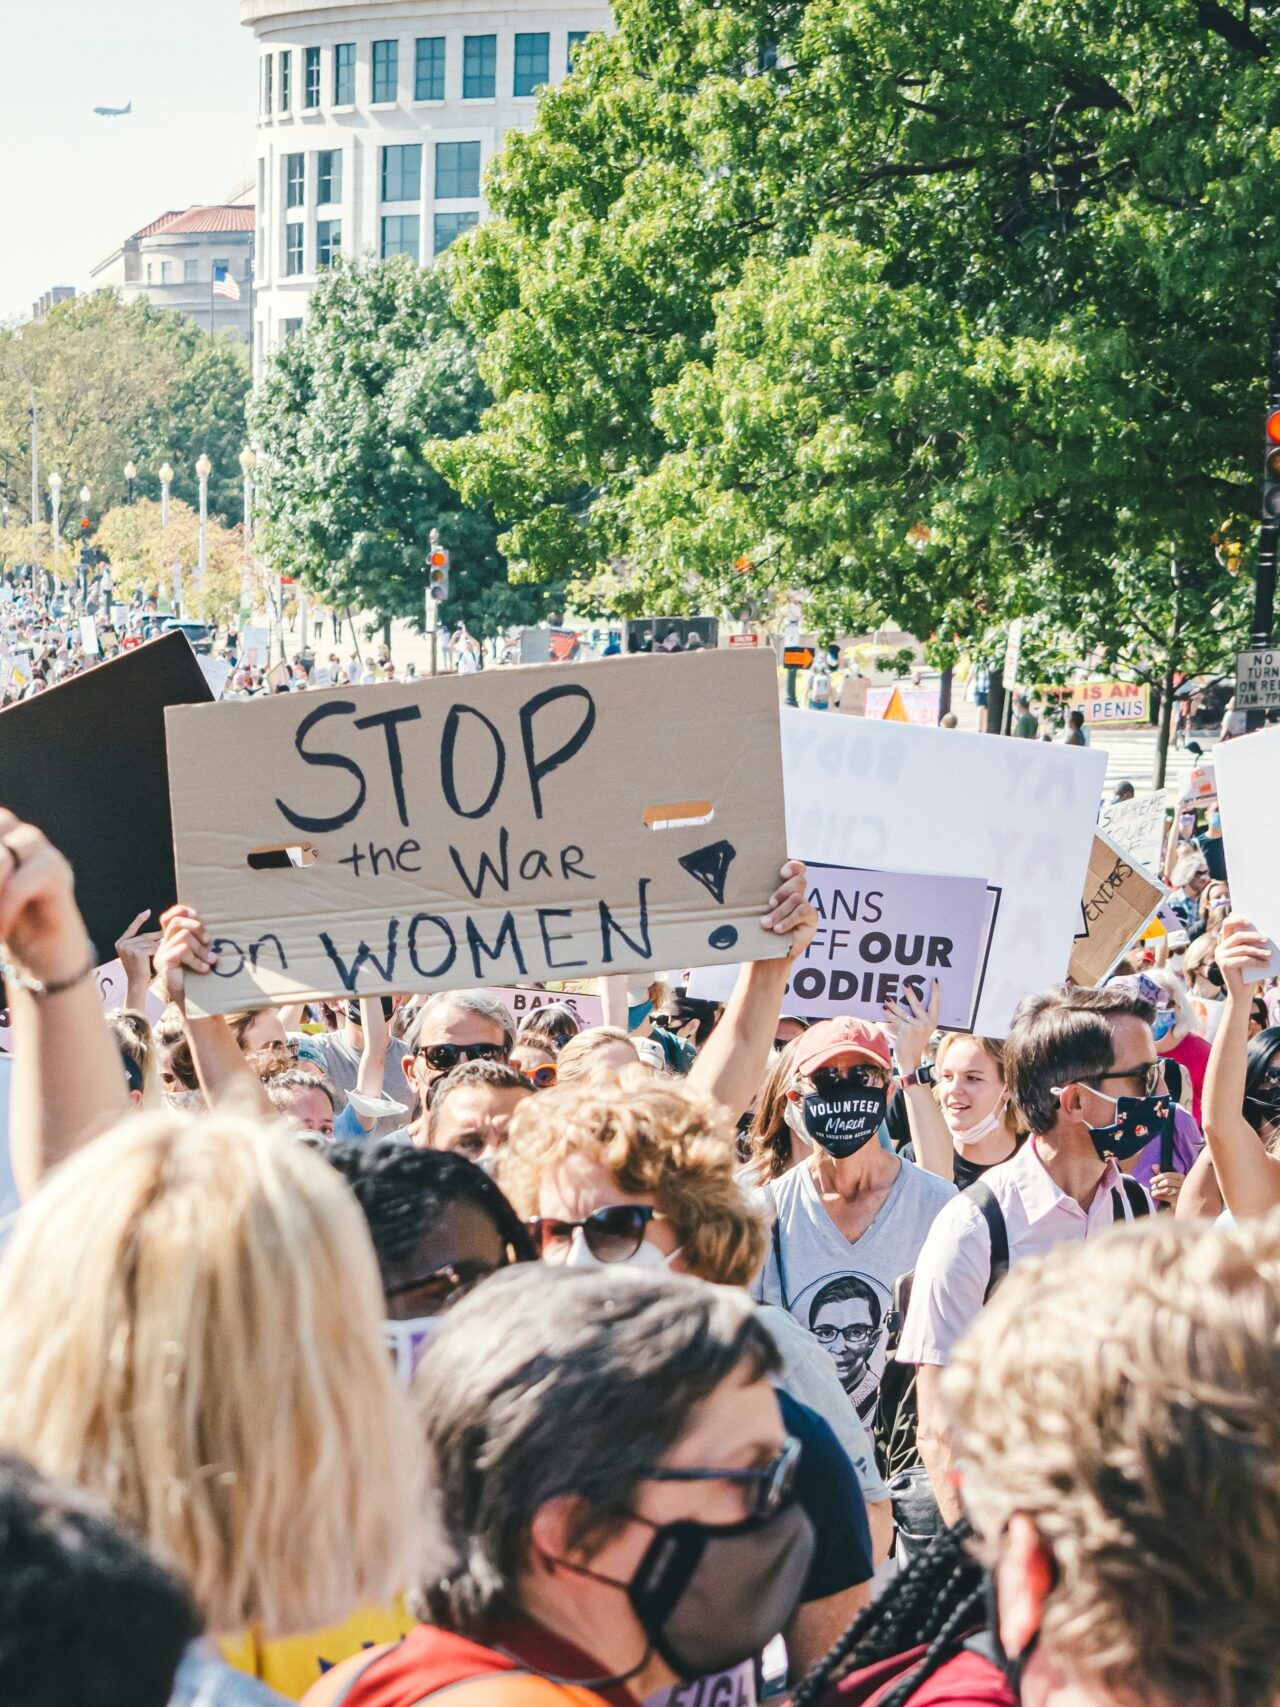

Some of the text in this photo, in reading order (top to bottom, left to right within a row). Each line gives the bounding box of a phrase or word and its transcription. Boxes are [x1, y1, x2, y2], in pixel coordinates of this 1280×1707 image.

[1253, 654, 1273, 666] NO
[1248, 667, 1279, 679] TURN
[1083, 685, 1139, 700] IS AN
[1239, 679, 1280, 692] ON RE
[1239, 693, 1280, 705] 7AM-7P
[1092, 700, 1144, 718] PENIS
[274, 683, 597, 833] STOP
[338, 837, 422, 878] the
[808, 887, 885, 924] ANS
[209, 932, 288, 979] on
[805, 928, 954, 968] FF OUR
[784, 967, 927, 1006] ODIES
[809, 1099, 880, 1118] VOLUNTEER
